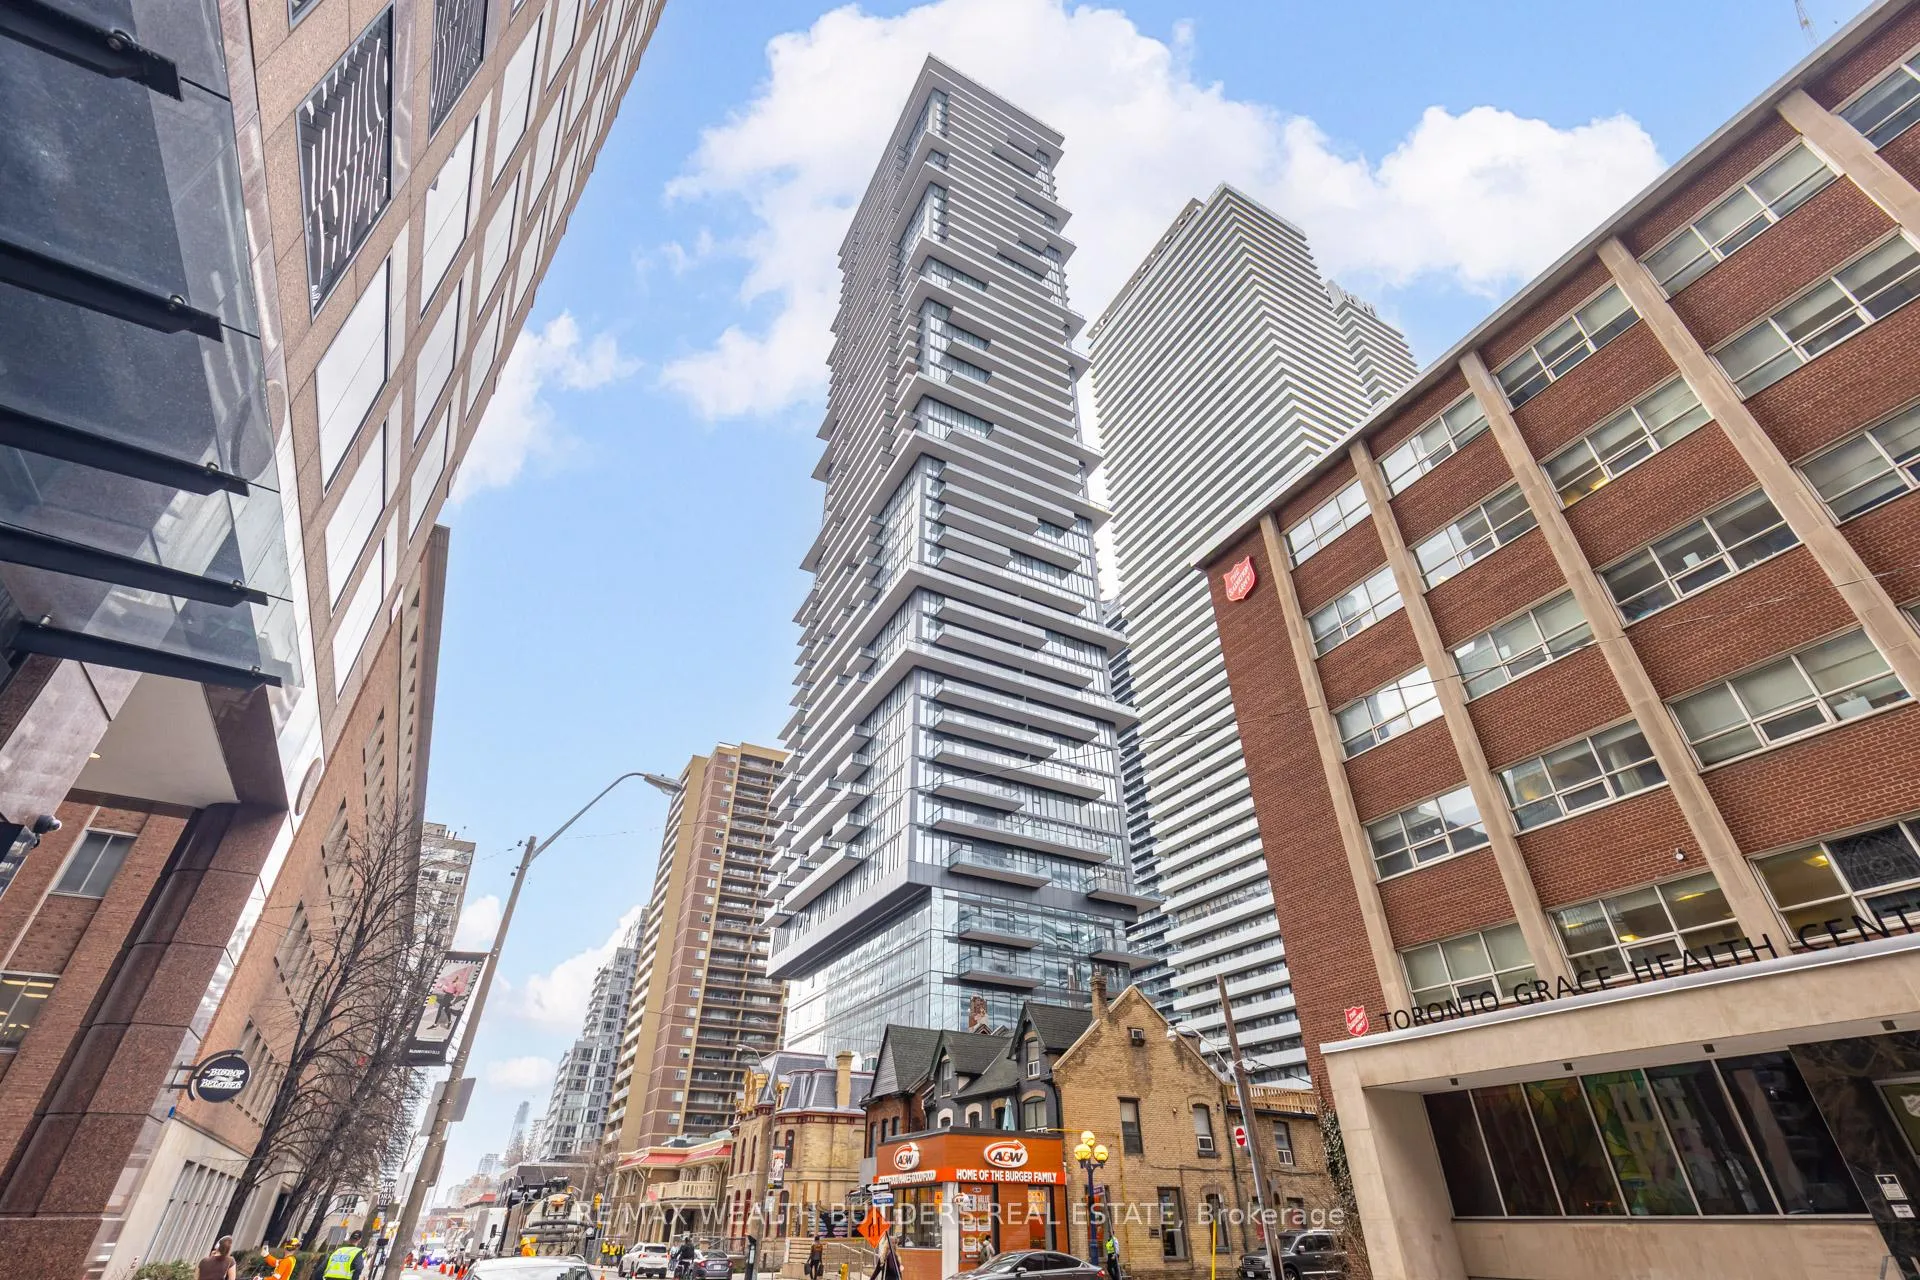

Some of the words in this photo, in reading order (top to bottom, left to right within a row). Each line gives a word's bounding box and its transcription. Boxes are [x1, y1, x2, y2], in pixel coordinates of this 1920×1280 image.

[1380, 990, 1499, 1031] TORONTO
[1513, 966, 1616, 1005] GRACE
[1629, 933, 1779, 983] HEALTH
[1799, 902, 1920, 951] CENT
[993, 1151, 1023, 1162] A&W
[956, 1169, 977, 1180] HOME
[979, 1170, 989, 1180] OF
[991, 1170, 1004, 1181] THE
[1006, 1171, 1032, 1182] BURGER
[1034, 1172, 1056, 1183] FAMILY
